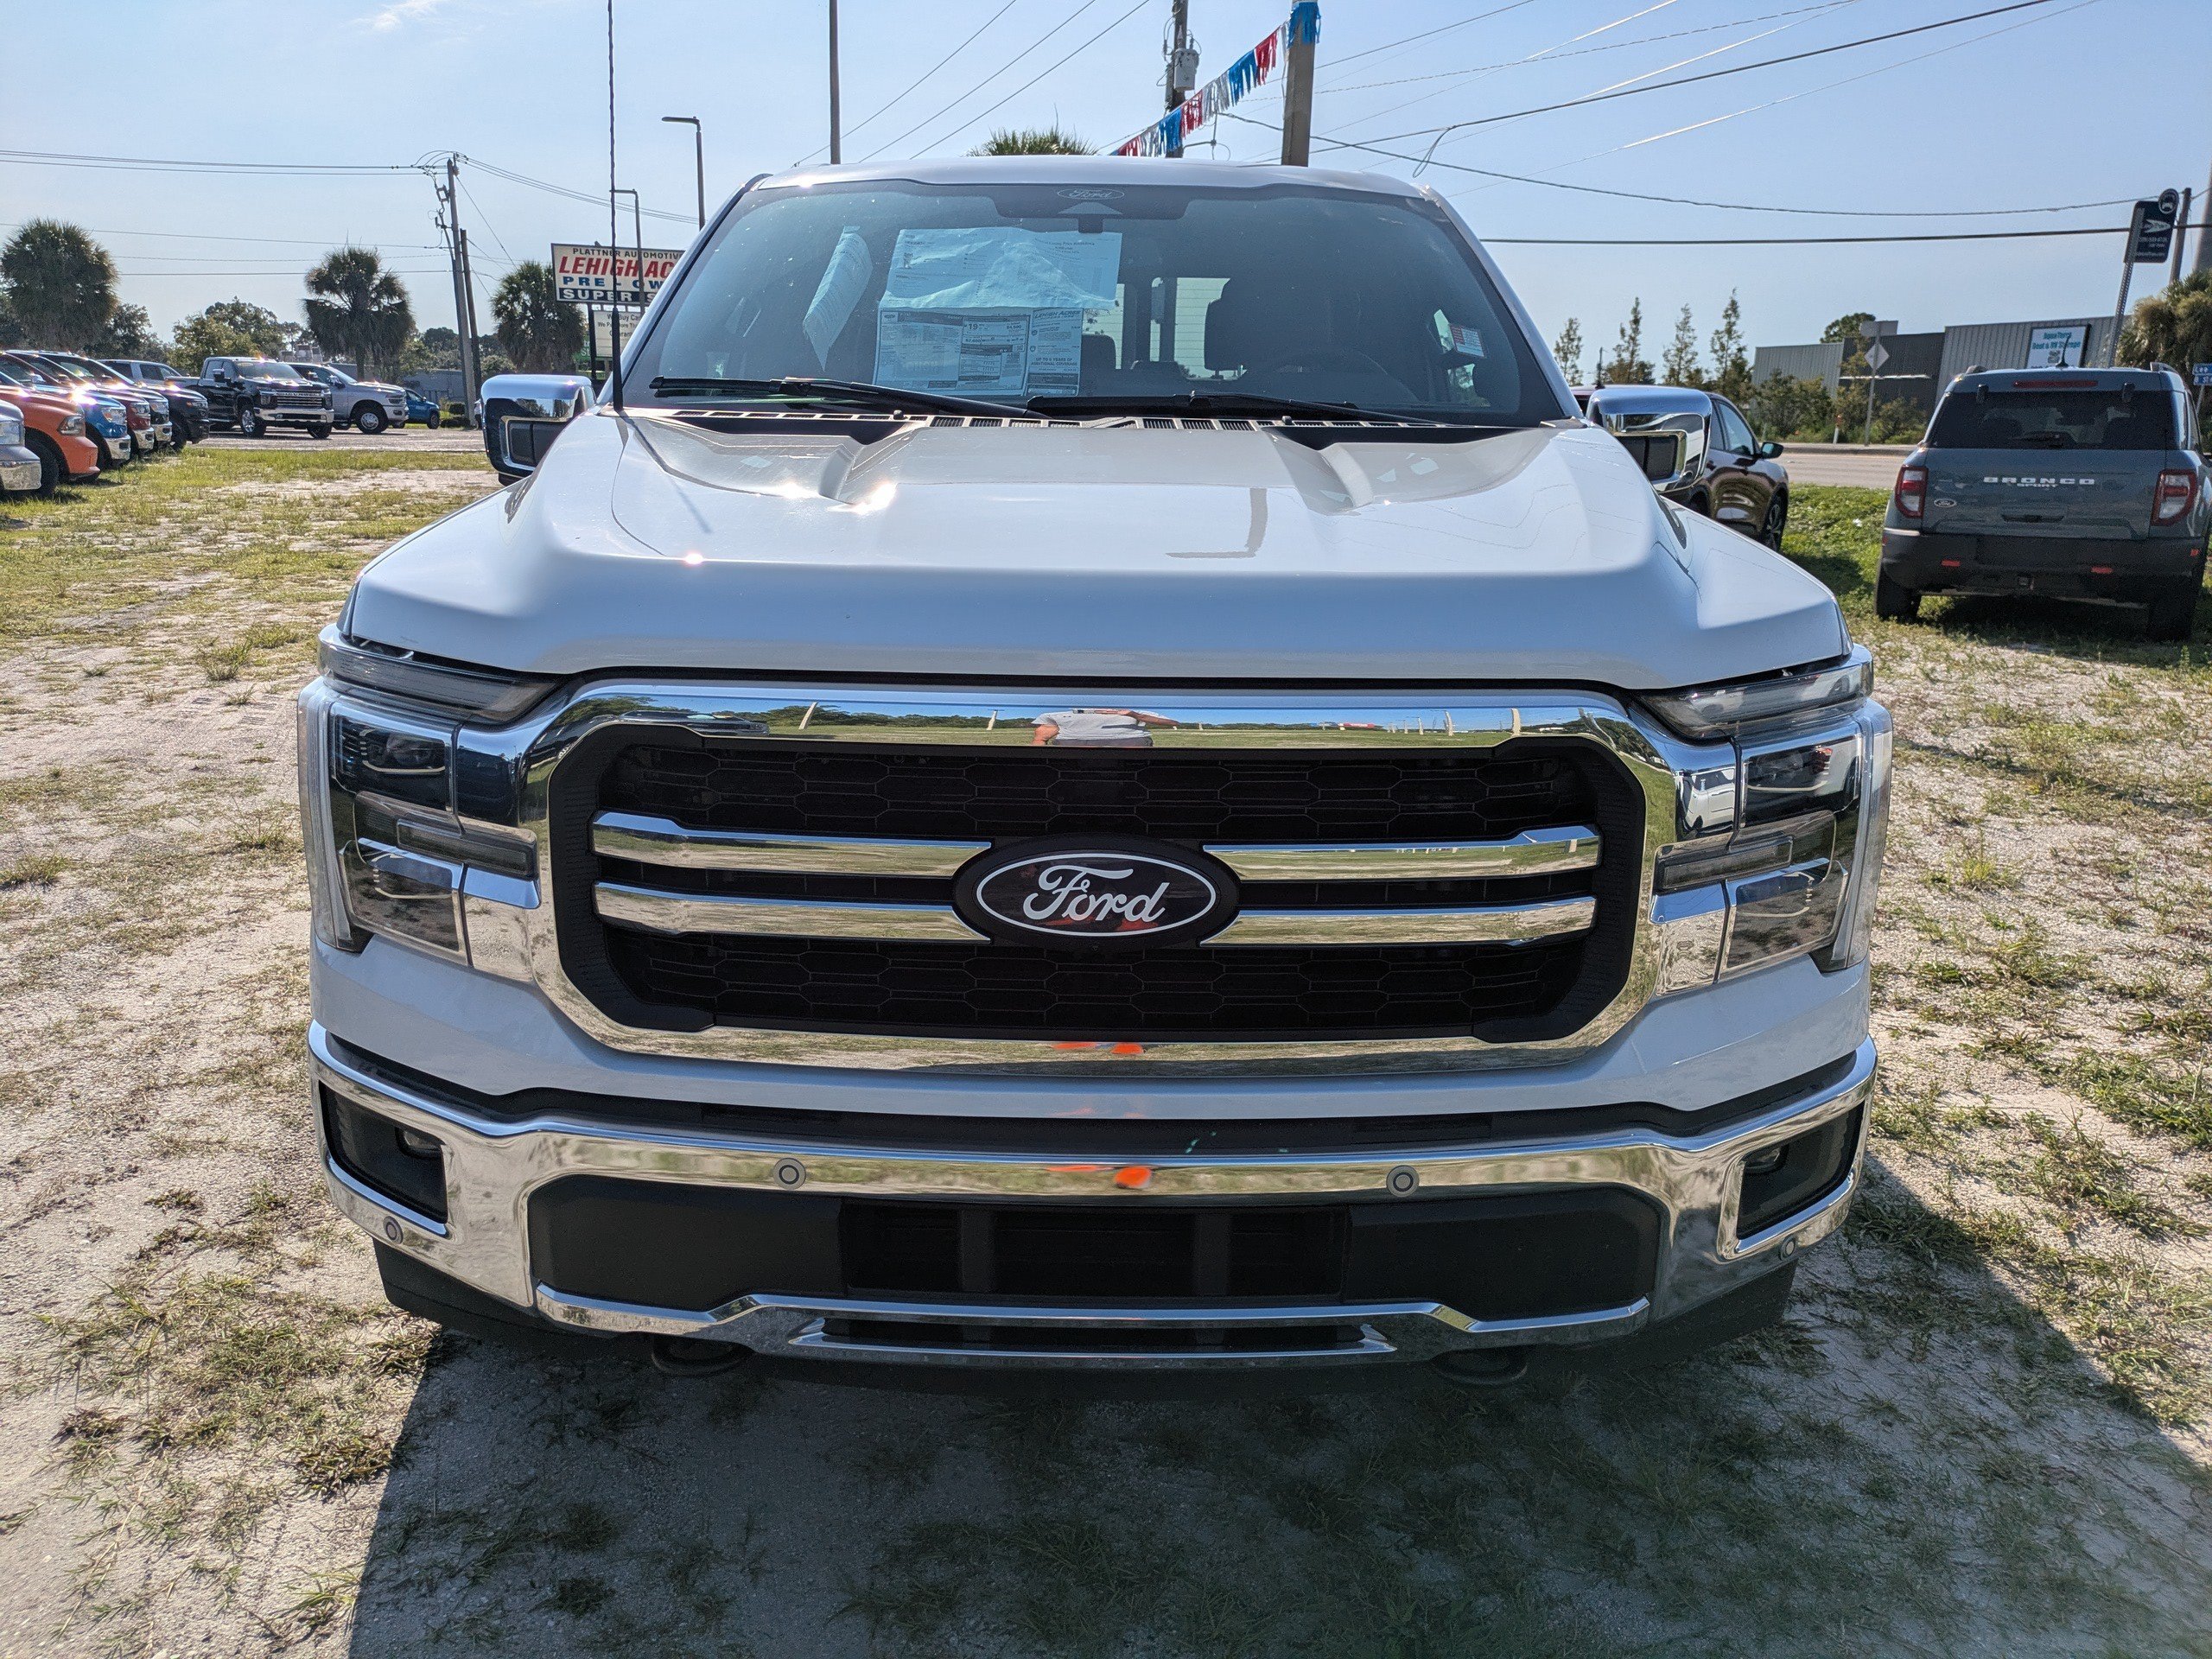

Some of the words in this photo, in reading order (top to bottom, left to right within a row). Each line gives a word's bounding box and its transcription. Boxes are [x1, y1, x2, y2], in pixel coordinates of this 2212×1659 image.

[558, 257, 640, 277] LEHIGH
[563, 276, 605, 287] PRE
[563, 289, 632, 302] SUPER
[1983, 477, 2095, 486] BRONCO
[1023, 863, 1172, 923] Ford
